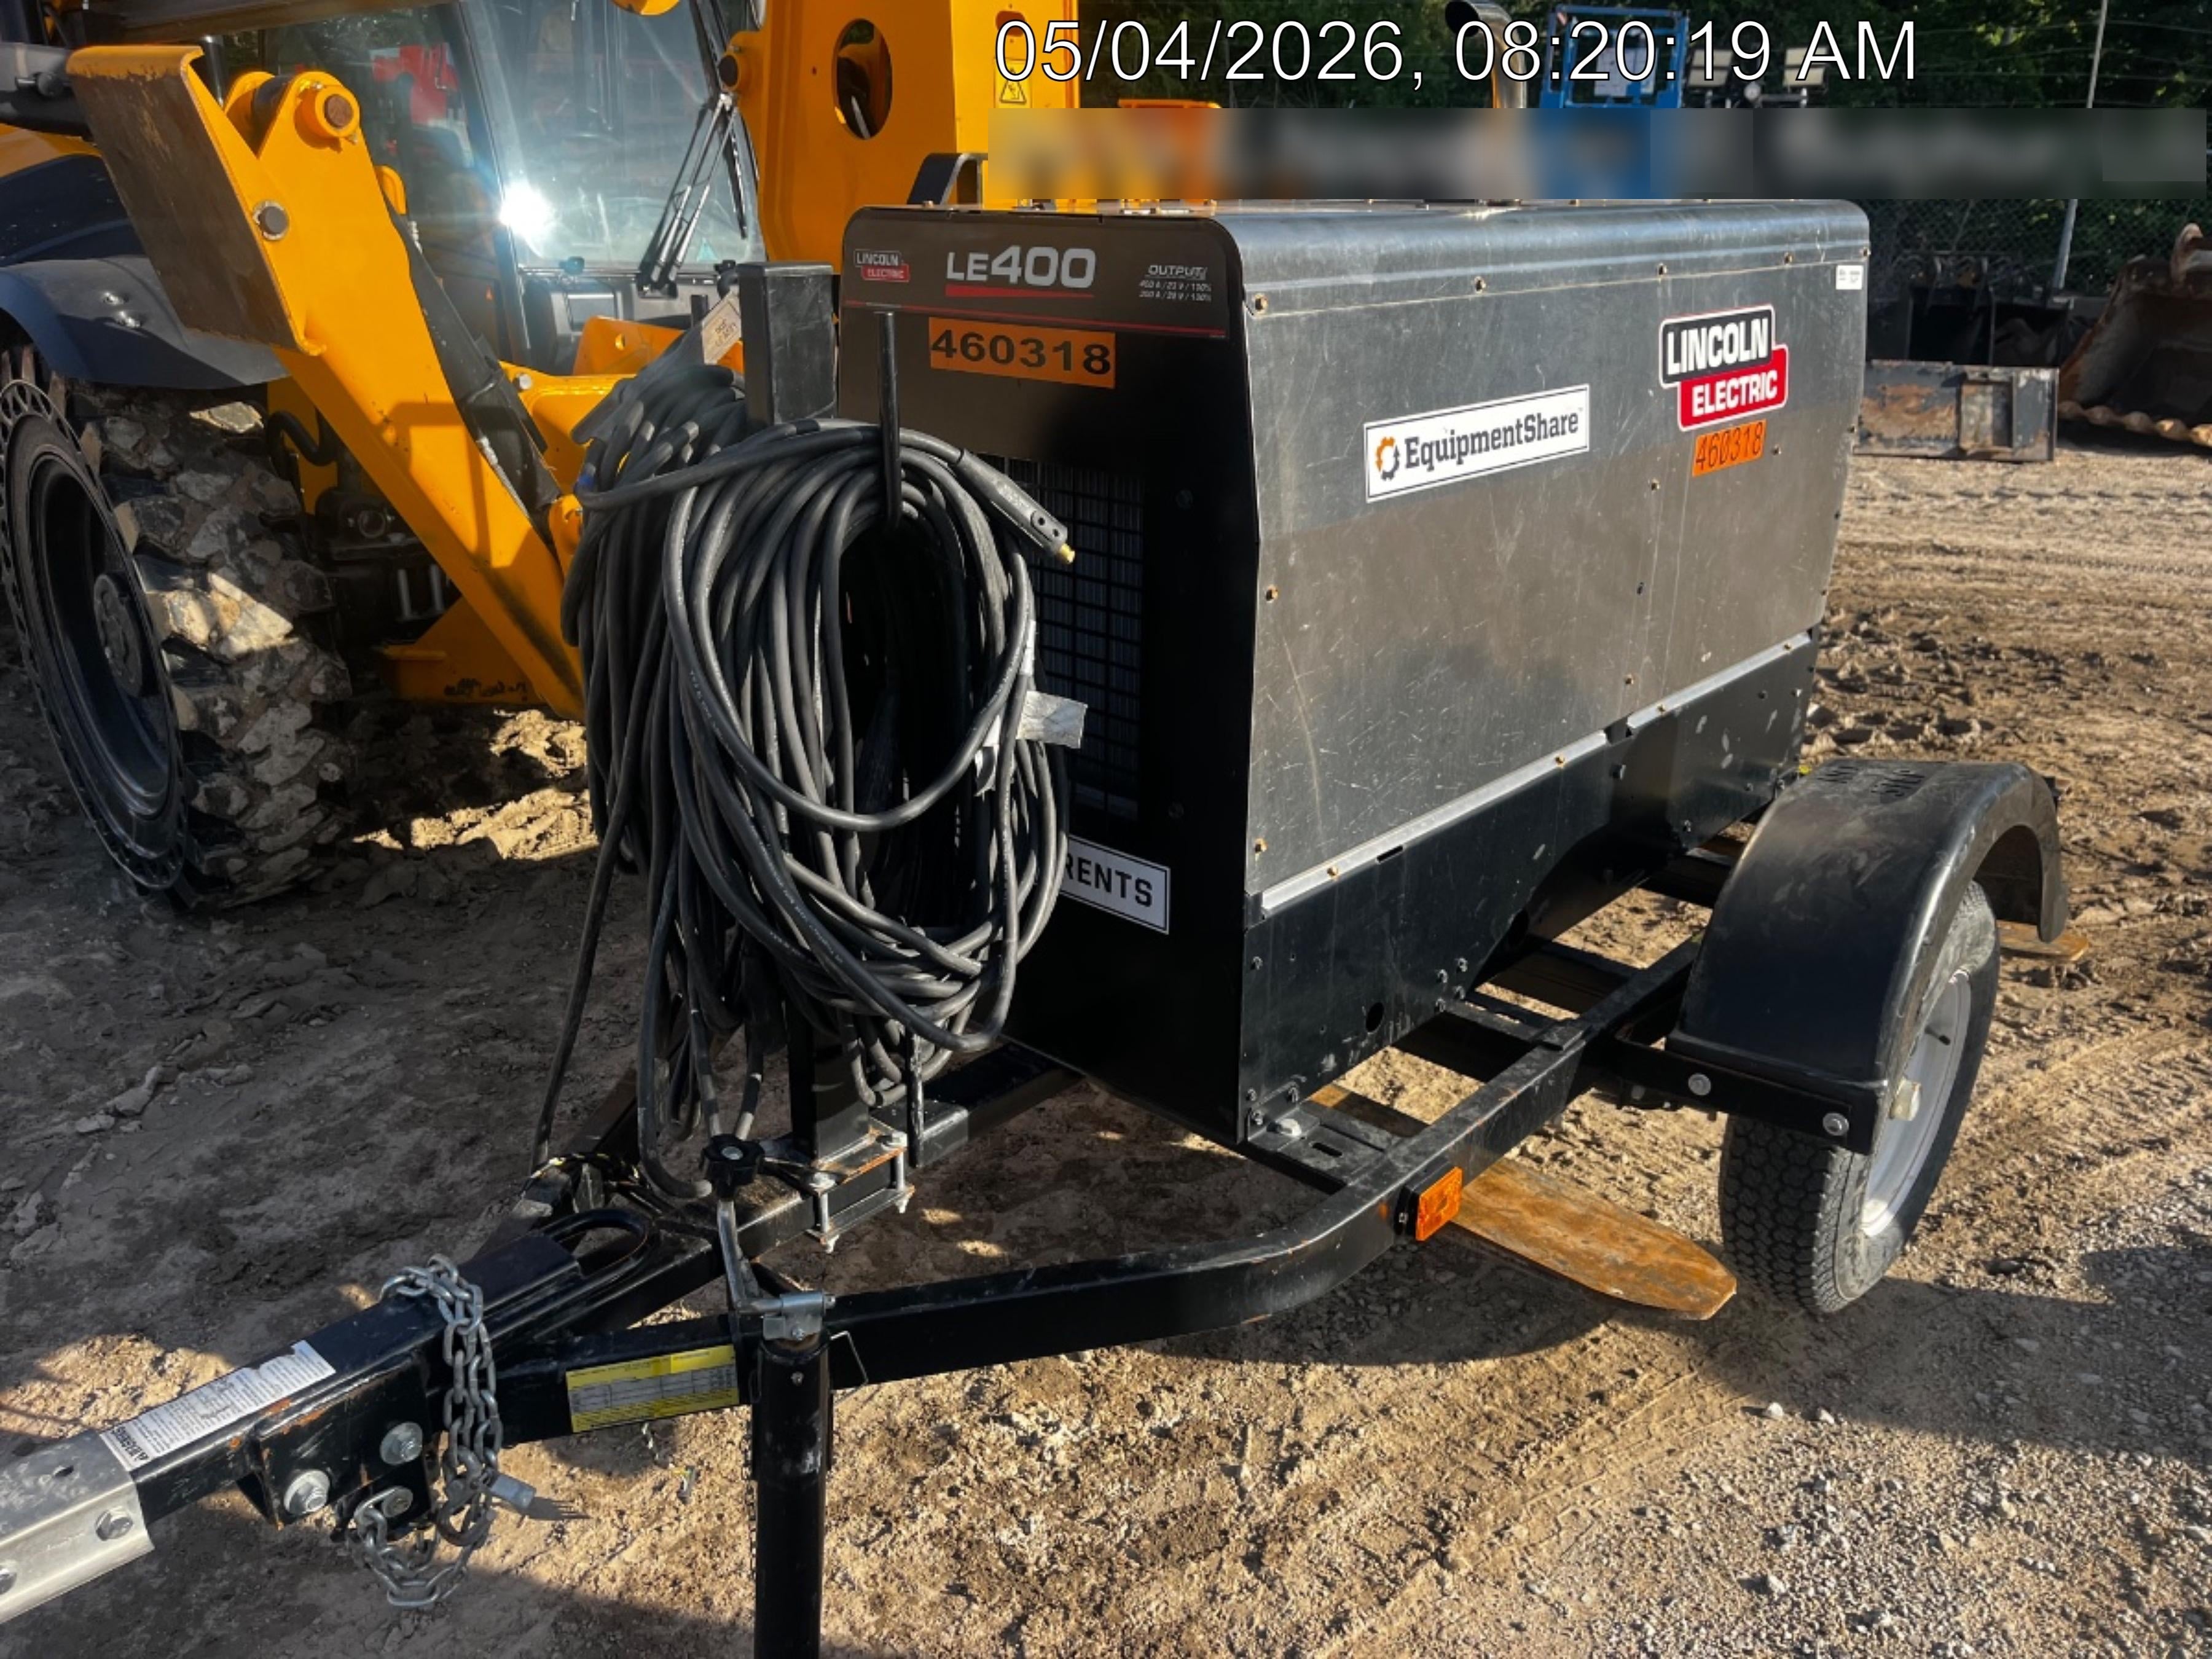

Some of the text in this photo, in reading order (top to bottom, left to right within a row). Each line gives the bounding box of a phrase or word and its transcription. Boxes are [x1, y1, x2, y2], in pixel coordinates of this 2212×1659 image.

[856, 252, 899, 266] LINCOLN
[946, 245, 1096, 289] LE400
[1147, 264, 1206, 277] OUTPUT
[931, 329, 1112, 375] 460318
[1666, 318, 1768, 375] LINCOLN
[1692, 369, 1778, 417] ELECTRIC
[1405, 412, 1579, 472] EquipmentShare
[1695, 422, 1763, 471] 460318
